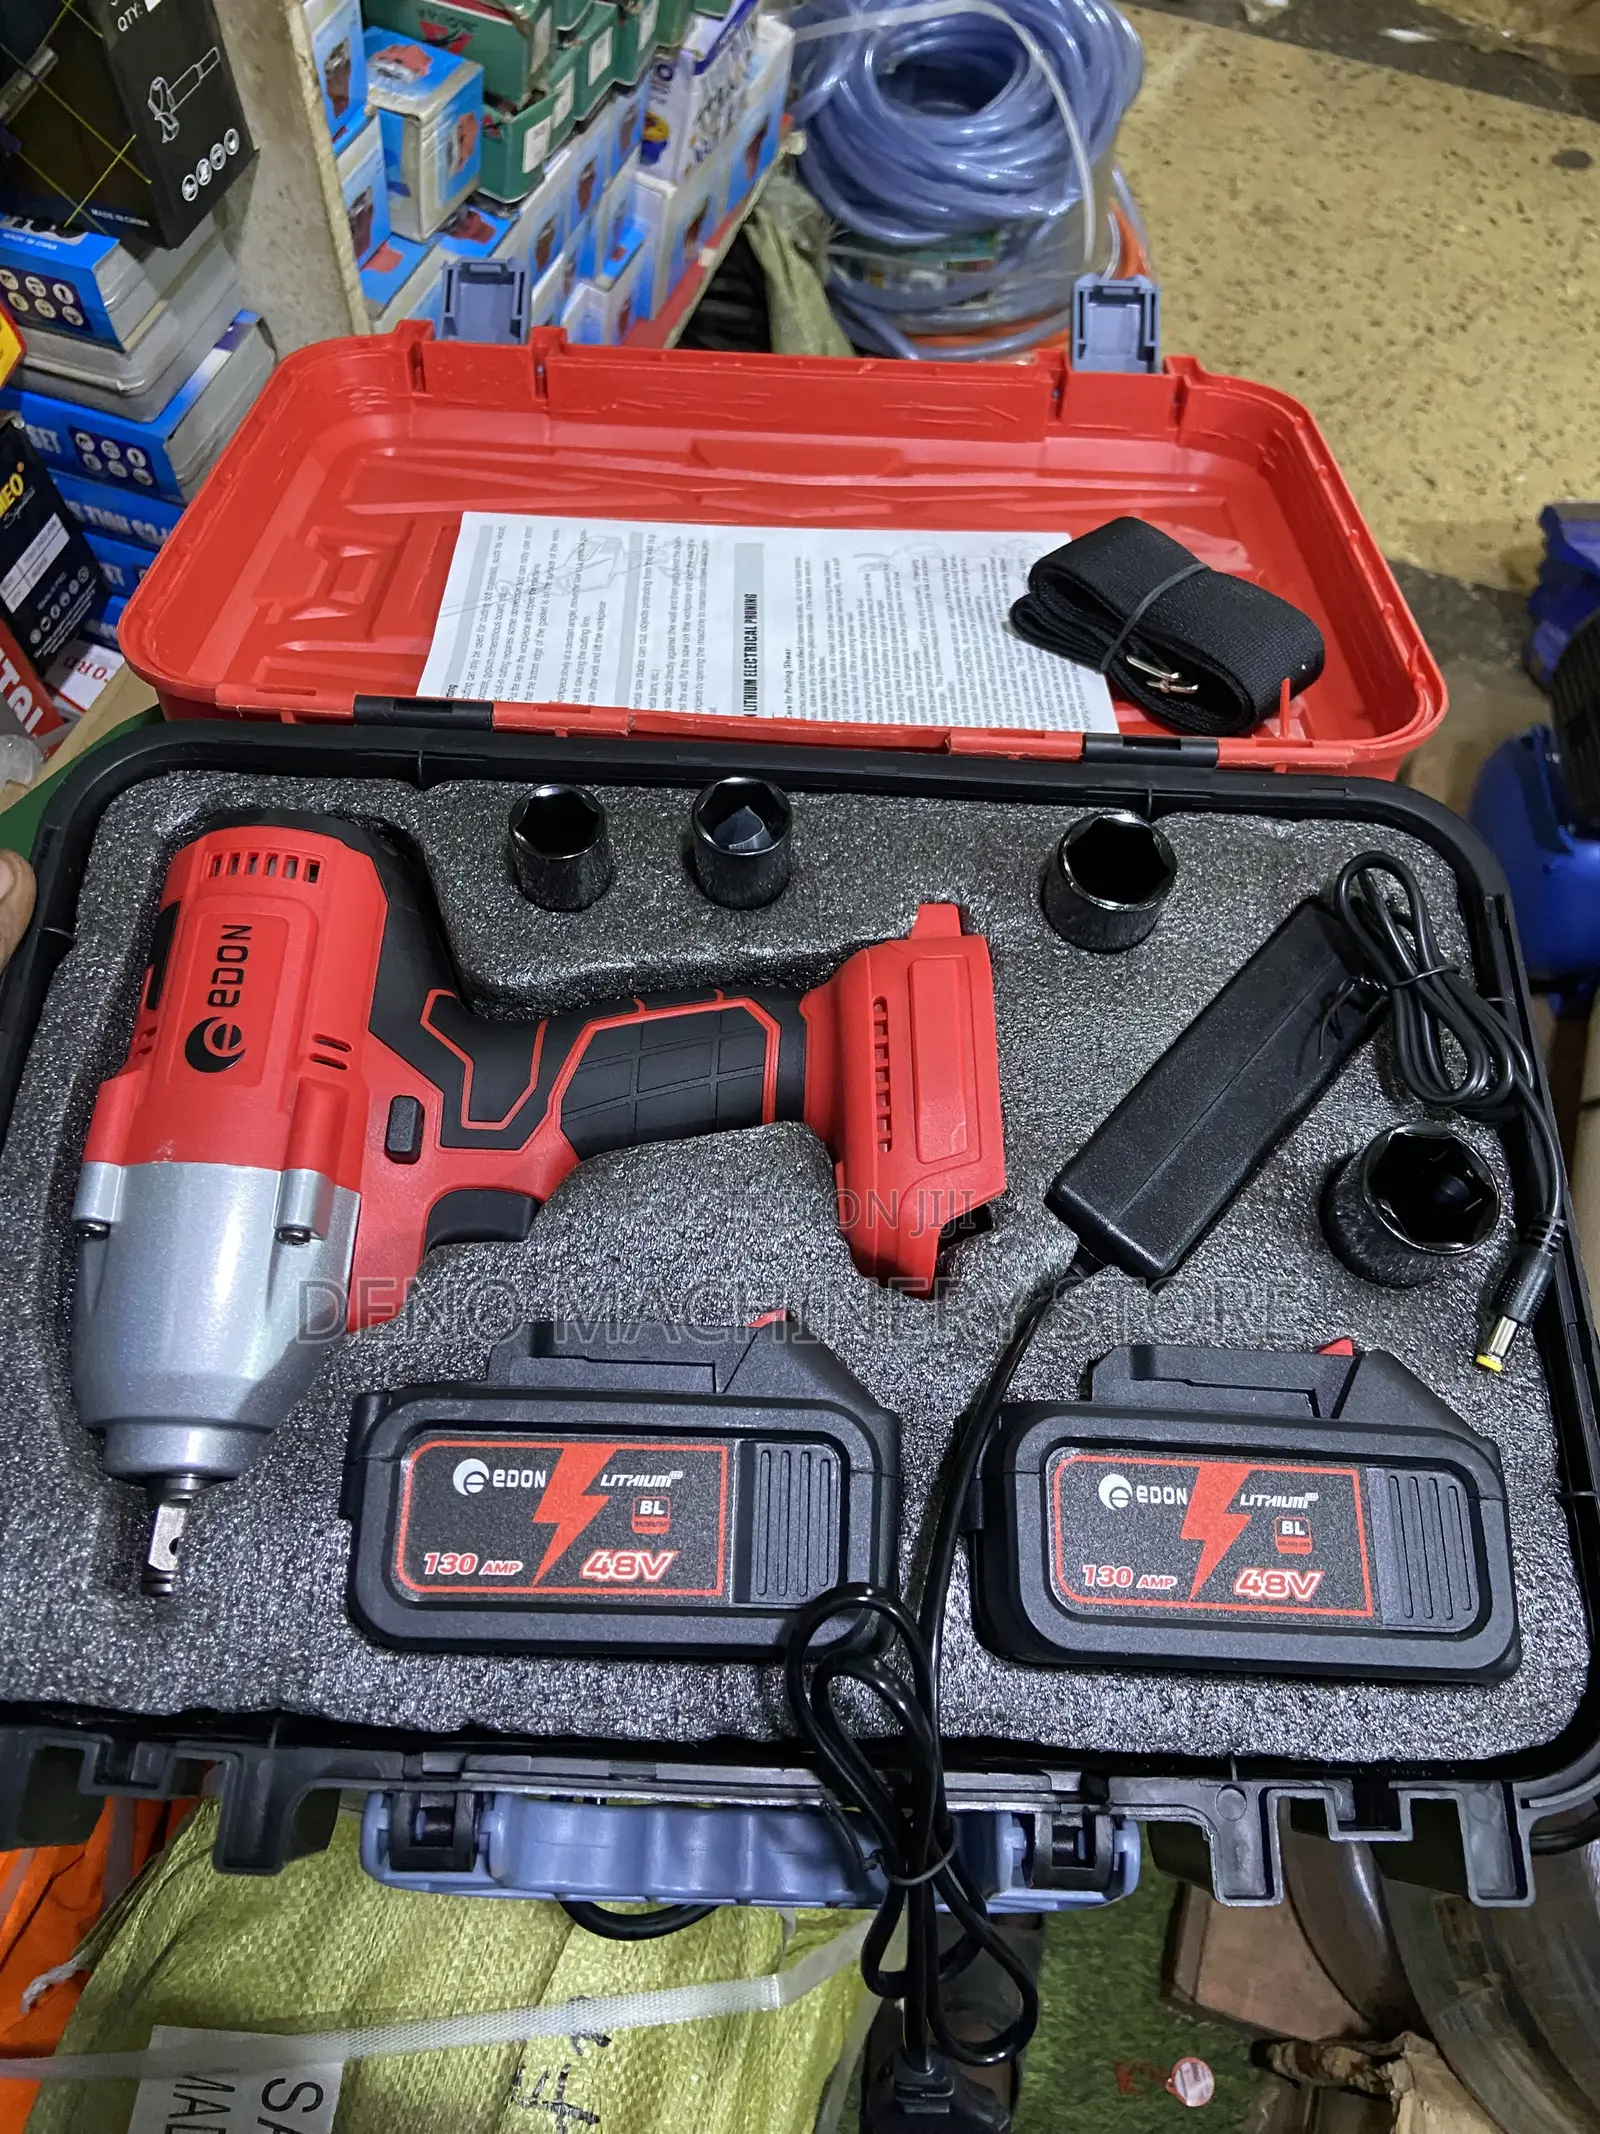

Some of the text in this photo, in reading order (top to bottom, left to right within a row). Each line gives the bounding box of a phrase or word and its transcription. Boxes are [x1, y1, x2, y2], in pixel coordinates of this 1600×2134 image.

[117, 2, 143, 32] QTY:
[522, 539, 530, 551] use
[643, 566, 651, 579] from
[523, 610, 532, 623] and
[595, 600, 607, 632] workpiece
[682, 592, 692, 621] workpiece
[506, 618, 515, 636] some
[696, 617, 704, 645] machine
[472, 634, 482, 649] used
[501, 636, 514, 660] requires
[517, 623, 531, 655] workpiece
[578, 628, 590, 650] cutting
[665, 635, 676, 660] against
[531, 647, 542, 662] edge
[637, 645, 645, 658] can
[743, 592, 757, 712] LITHIUM ELECTRICAL PRUNING
[783, 647, 791, 669] Shear
[575, 660, 586, 675] along
[635, 658, 644, 679] blades
[694, 657, 704, 682] opening
[783, 669, 794, 694] Pruning
[600, 1473, 673, 1488] LITHIUM
[640, 1500, 665, 1515] BL
[1239, 1493, 1309, 1509] LITHIUM
[1281, 1520, 1306, 1536] BL
[423, 1552, 523, 1576] 130 AMP
[580, 1550, 679, 1582] 48V
[1082, 1564, 1178, 1590] 130 AMP
[1234, 1569, 1325, 1601] 48V
